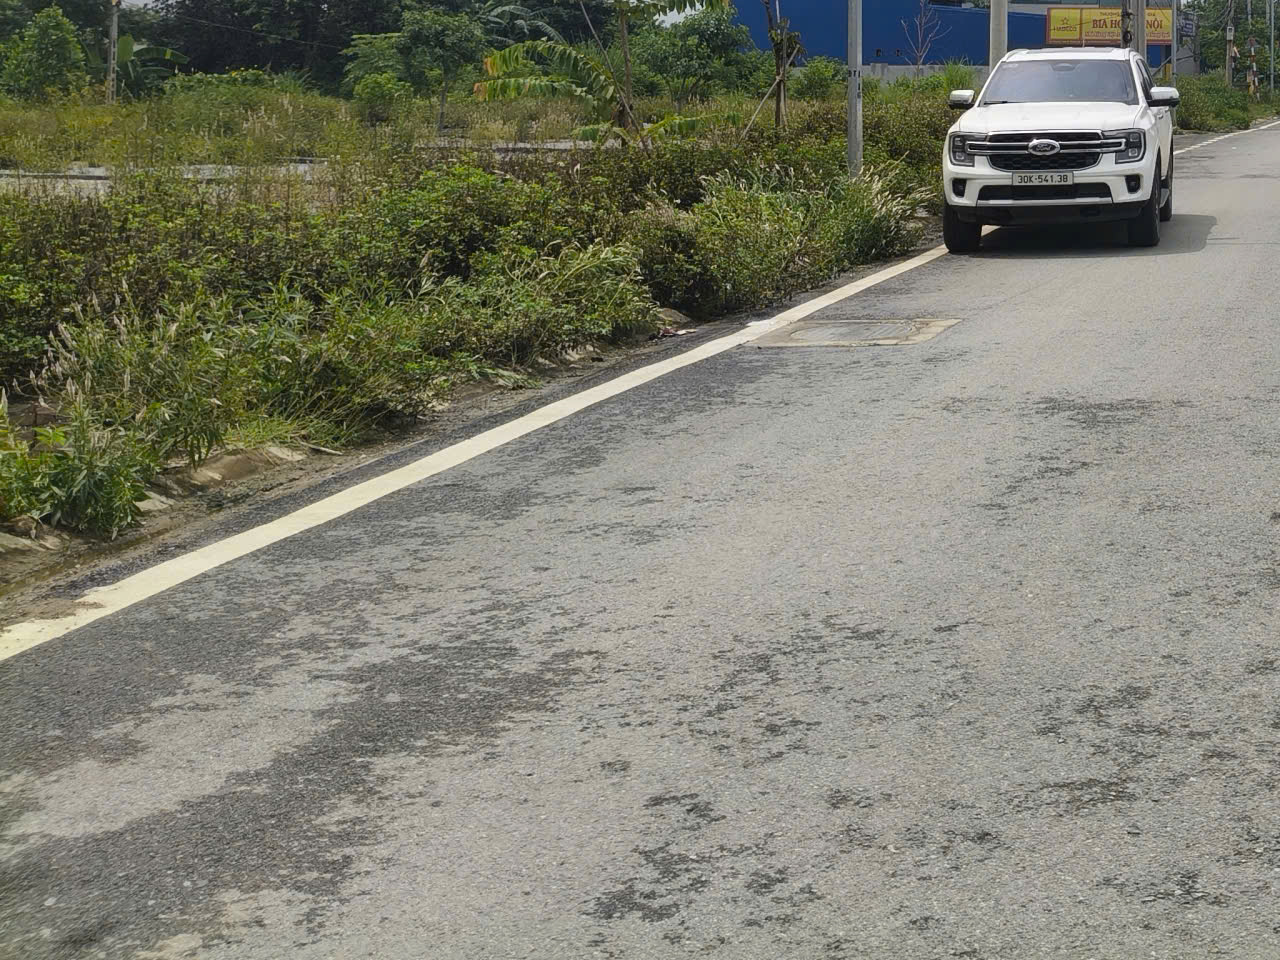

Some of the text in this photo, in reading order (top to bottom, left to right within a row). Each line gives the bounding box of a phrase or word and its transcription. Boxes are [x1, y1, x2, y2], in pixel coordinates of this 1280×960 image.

[1092, 19, 1107, 29] BIA
[1146, 18, 1163, 31] NỘI
[1036, 143, 1052, 151] Ford
